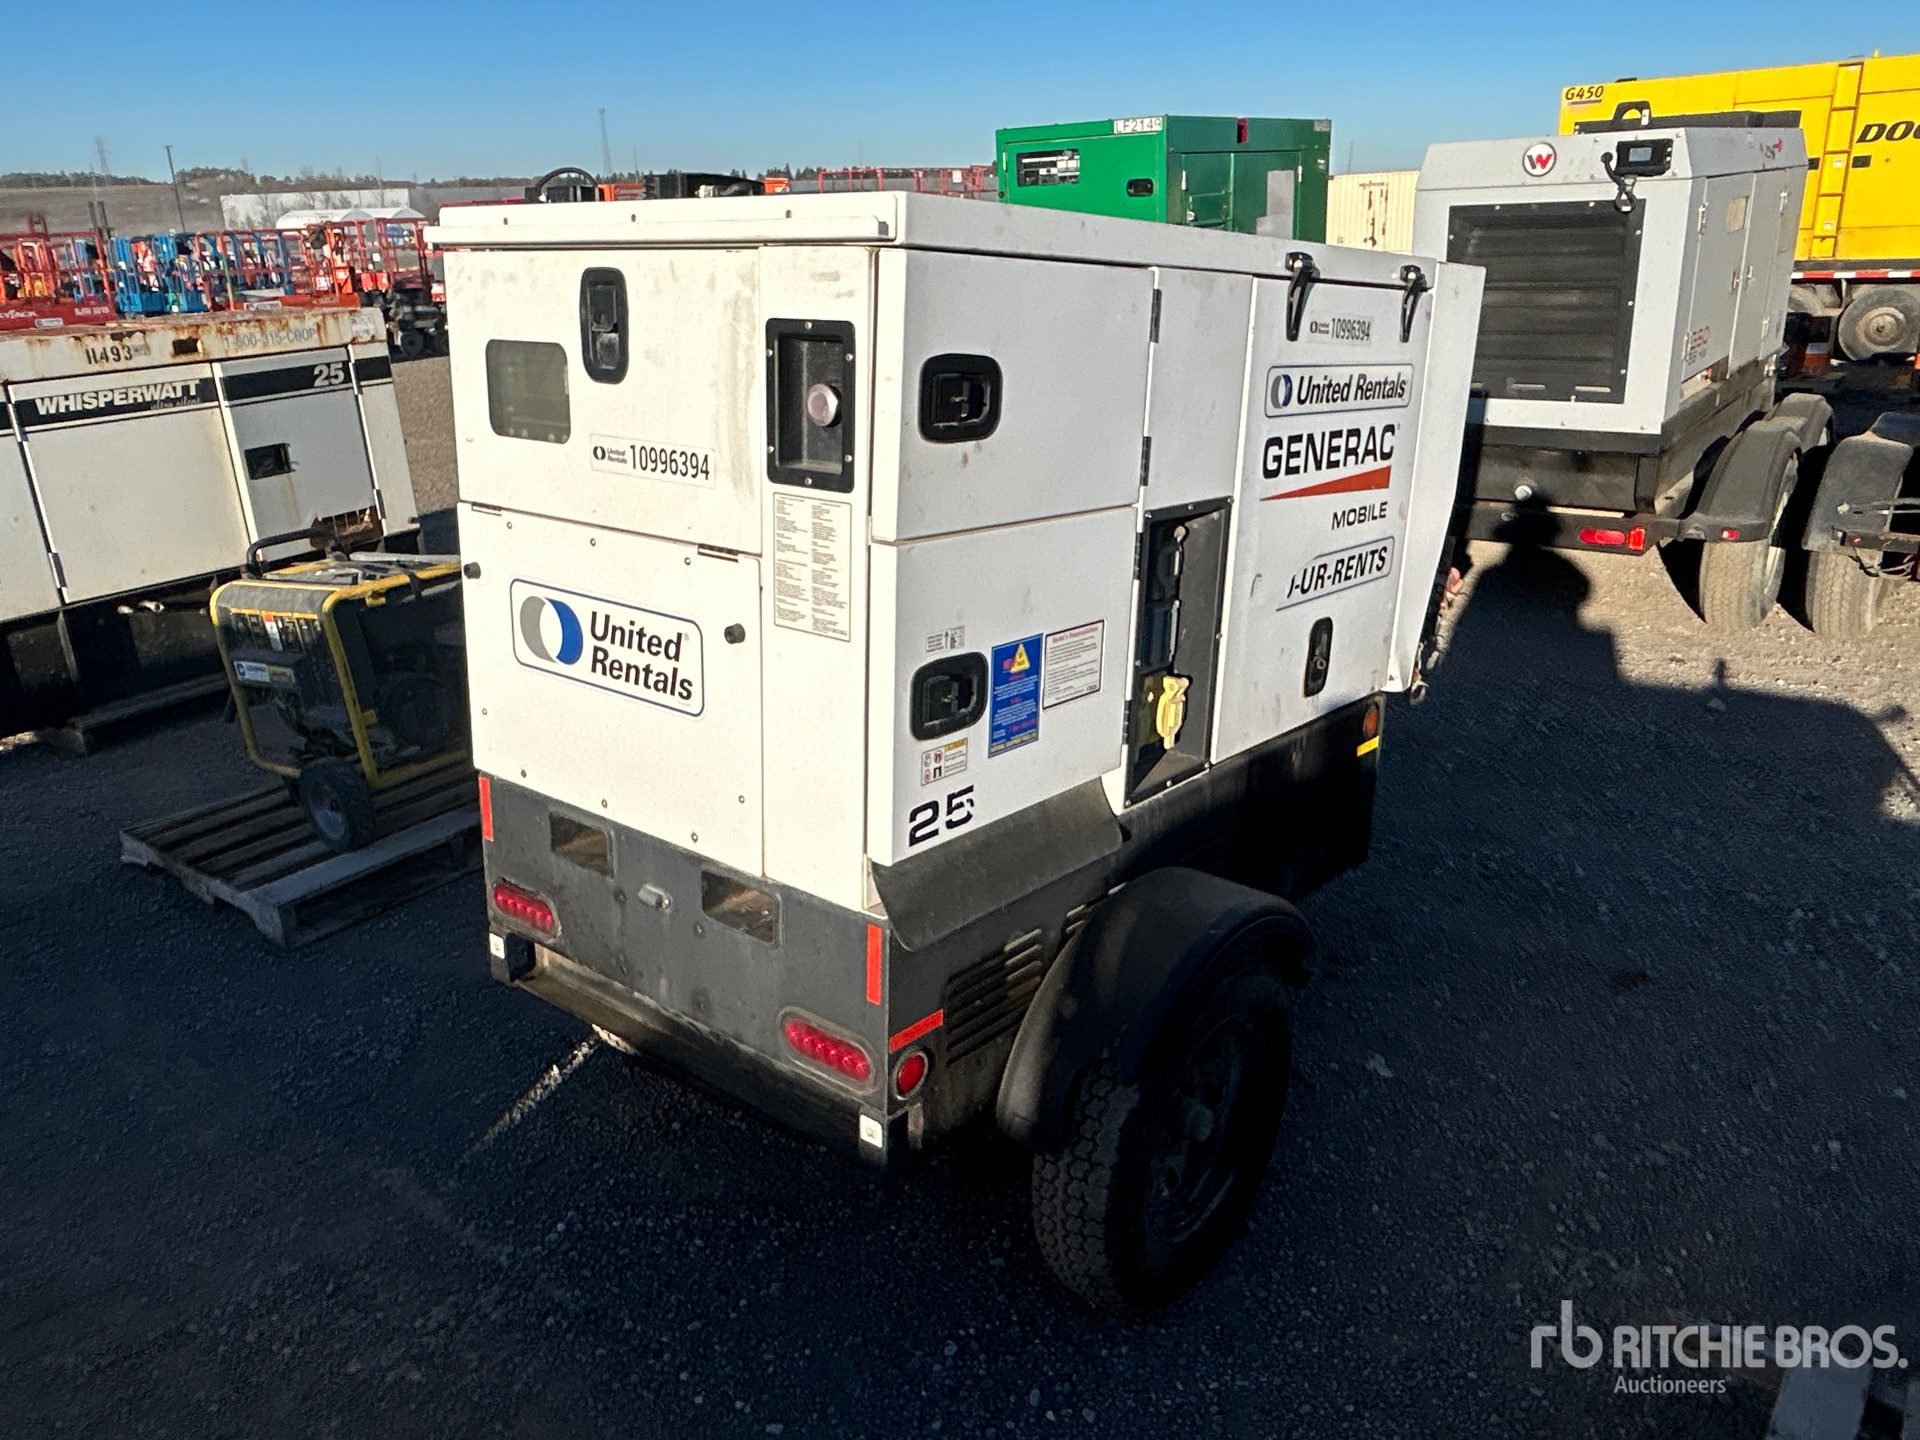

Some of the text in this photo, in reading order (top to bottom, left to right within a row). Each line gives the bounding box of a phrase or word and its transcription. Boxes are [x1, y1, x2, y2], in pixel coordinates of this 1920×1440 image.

[1565, 85, 1604, 101] G450
[1855, 120, 1920, 144] DO
[1331, 317, 1370, 341] 10996394
[313, 361, 345, 388] 25
[1296, 372, 1406, 406] United Rentals
[36, 380, 200, 415] WHISPERWATT
[629, 444, 710, 480] 10996394
[1262, 423, 1395, 480] GENERAC
[1331, 501, 1389, 531] MOBILE
[589, 610, 684, 663] United
[589, 645, 694, 702] Rentals
[908, 785, 975, 847] 25
